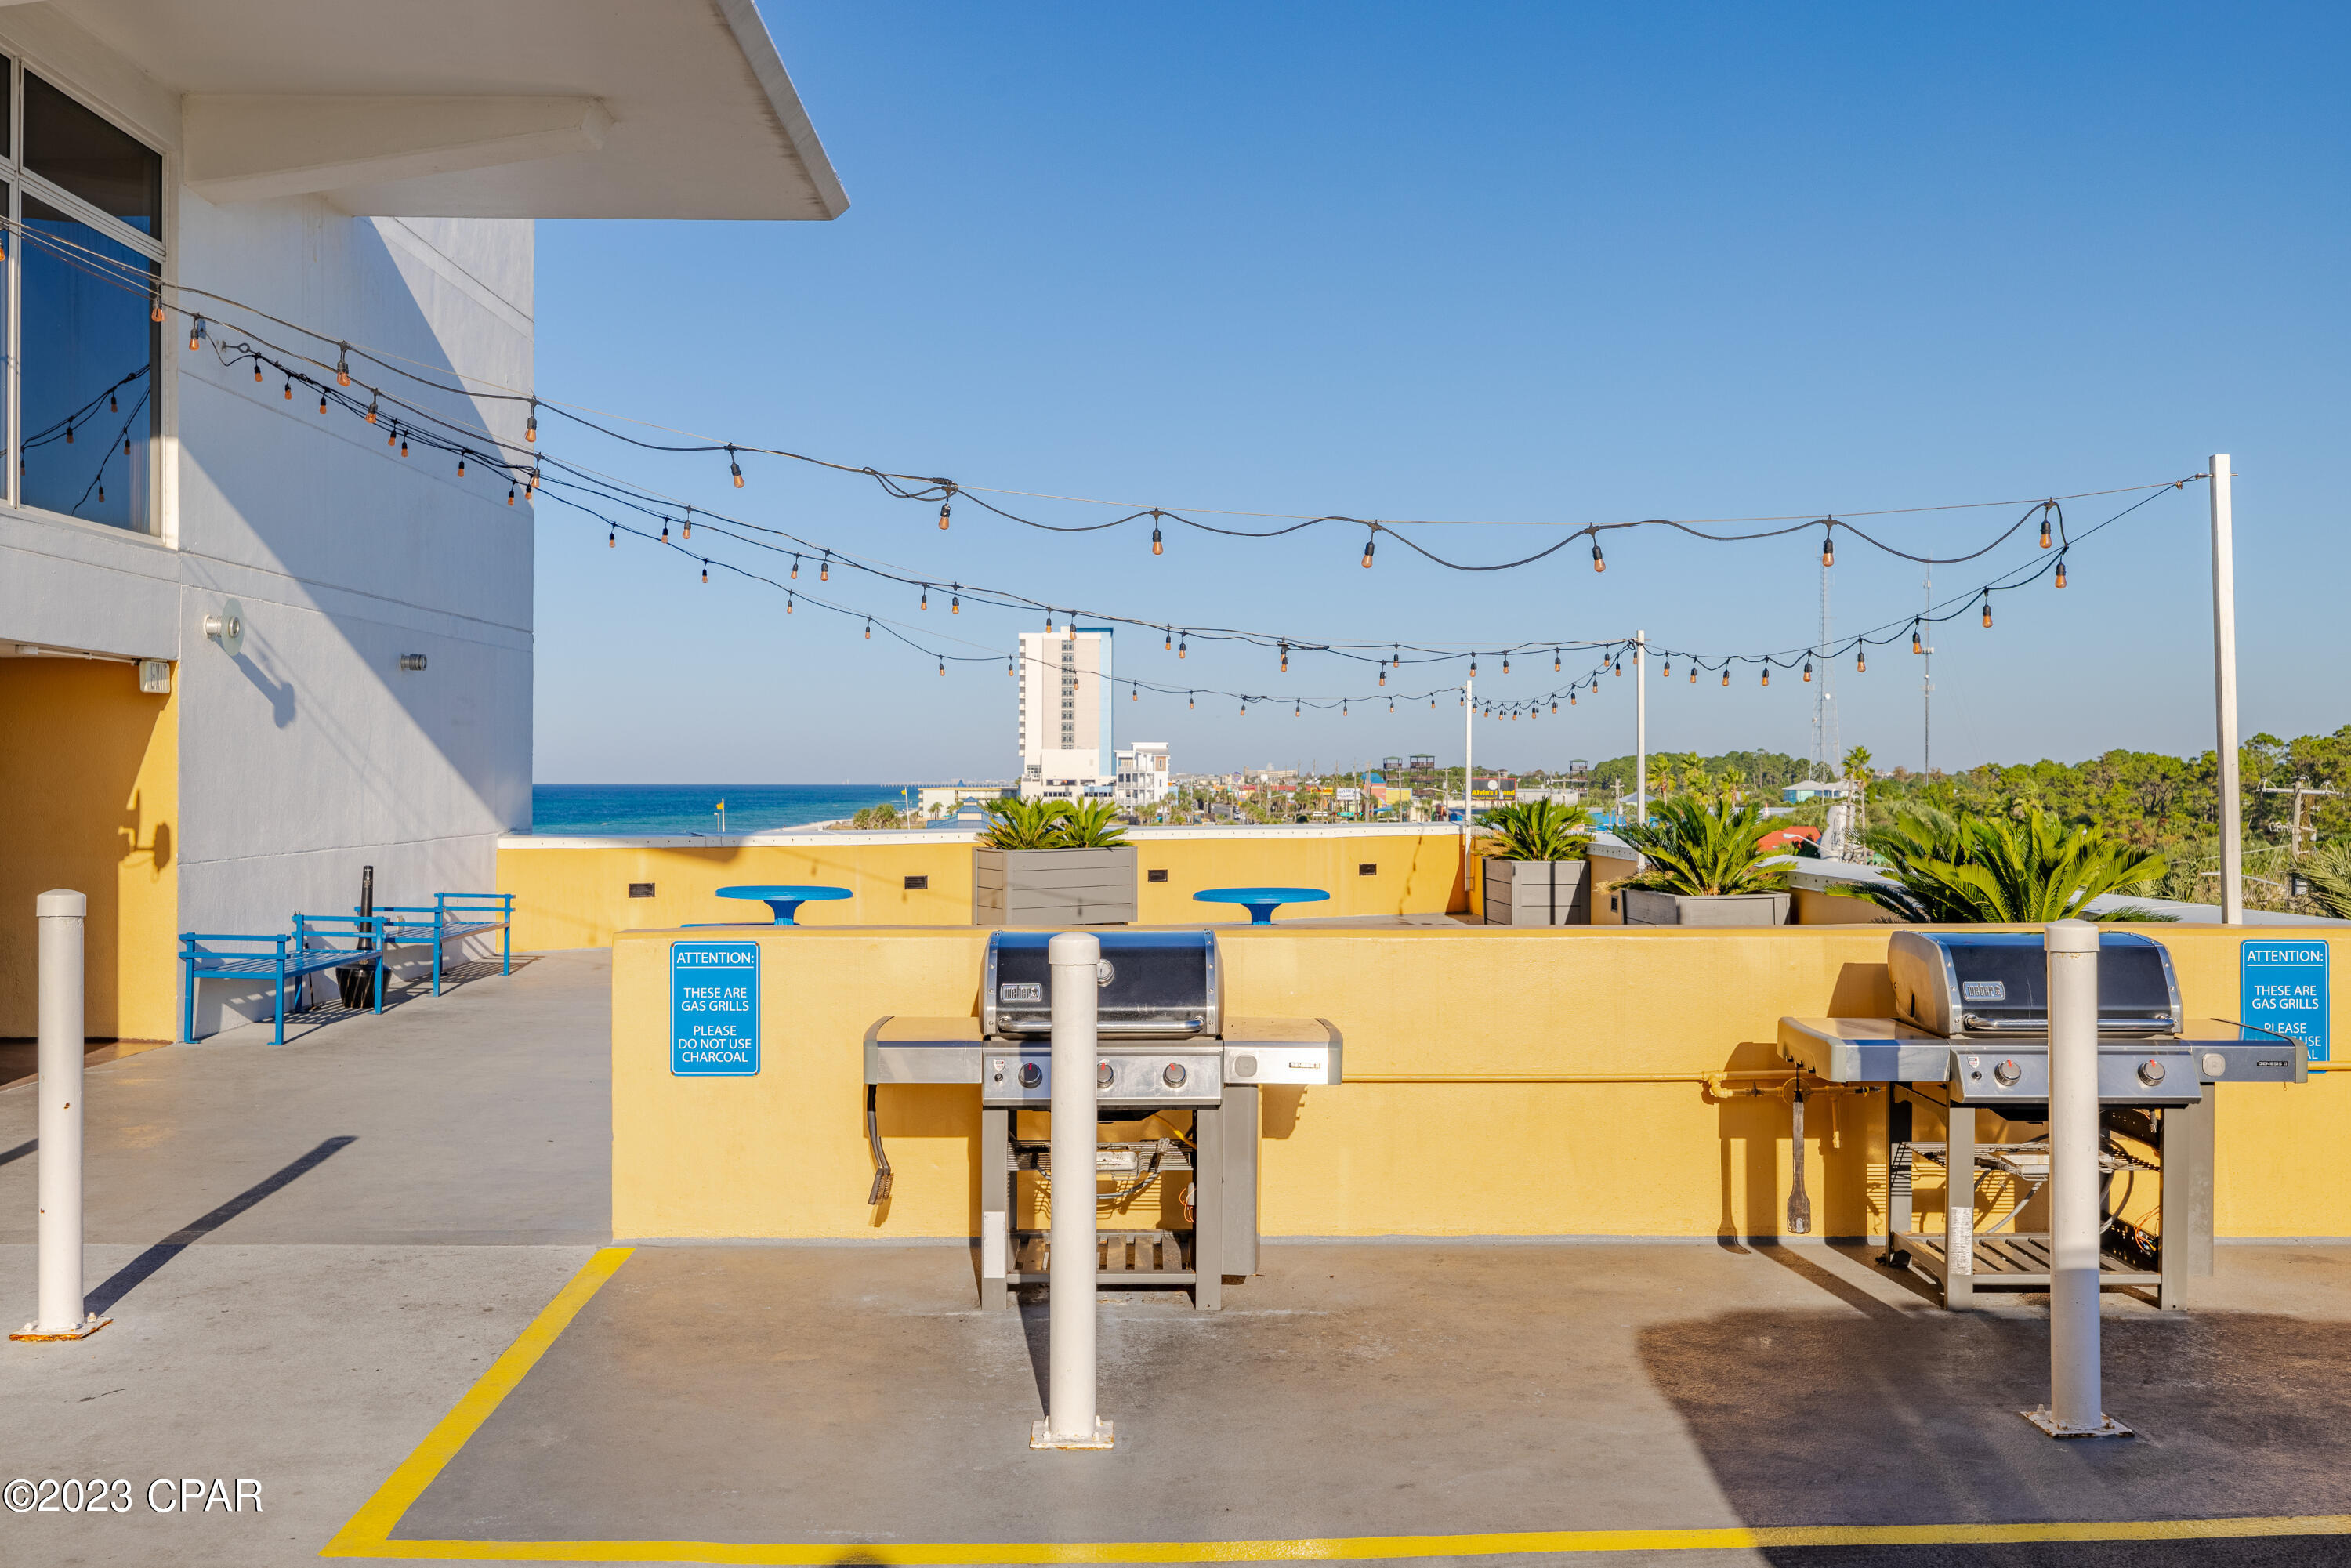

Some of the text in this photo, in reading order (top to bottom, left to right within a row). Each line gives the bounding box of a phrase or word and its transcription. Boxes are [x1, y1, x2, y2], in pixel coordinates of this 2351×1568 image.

[150, 662, 168, 690] EXIT
[676, 952, 755, 964] ATTENTION:
[2247, 950, 2324, 962] ATTENTION:
[683, 987, 747, 998] THESE ARE
[2254, 985, 2317, 996] THESE ARE
[681, 1001, 750, 1012] GAS GRILLS
[2251, 998, 2320, 1009] GAS GRILLS
[694, 1025, 737, 1036] PLEASE
[678, 1038, 752, 1049] DO NOT USE
[682, 1052, 748, 1063] CHARCOAL
